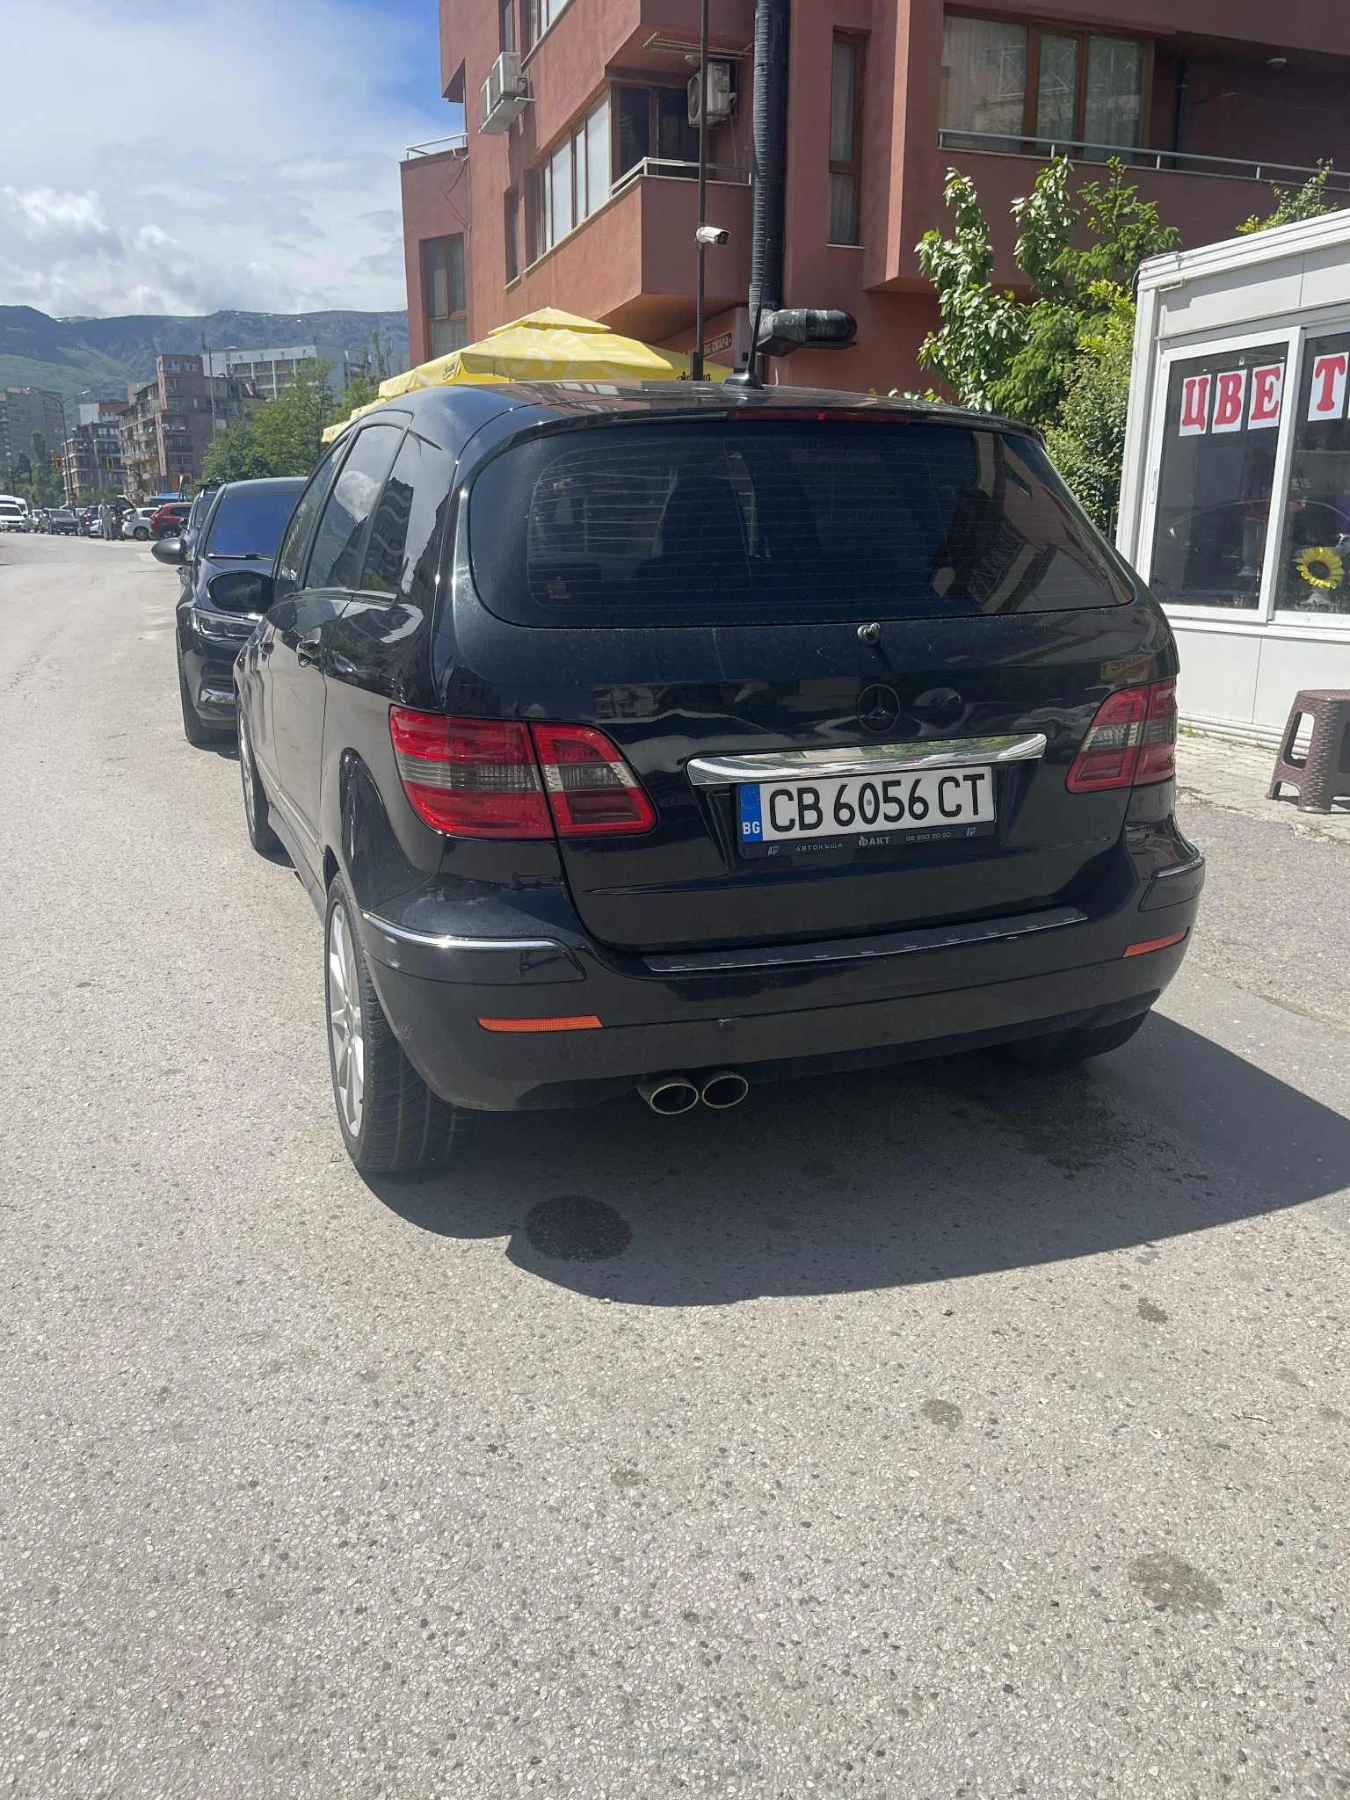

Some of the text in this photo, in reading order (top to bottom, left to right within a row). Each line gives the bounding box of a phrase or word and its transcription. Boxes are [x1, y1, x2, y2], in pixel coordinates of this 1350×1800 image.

[769, 774, 985, 833] CB 6056 CT
[742, 821, 761, 835] BG
